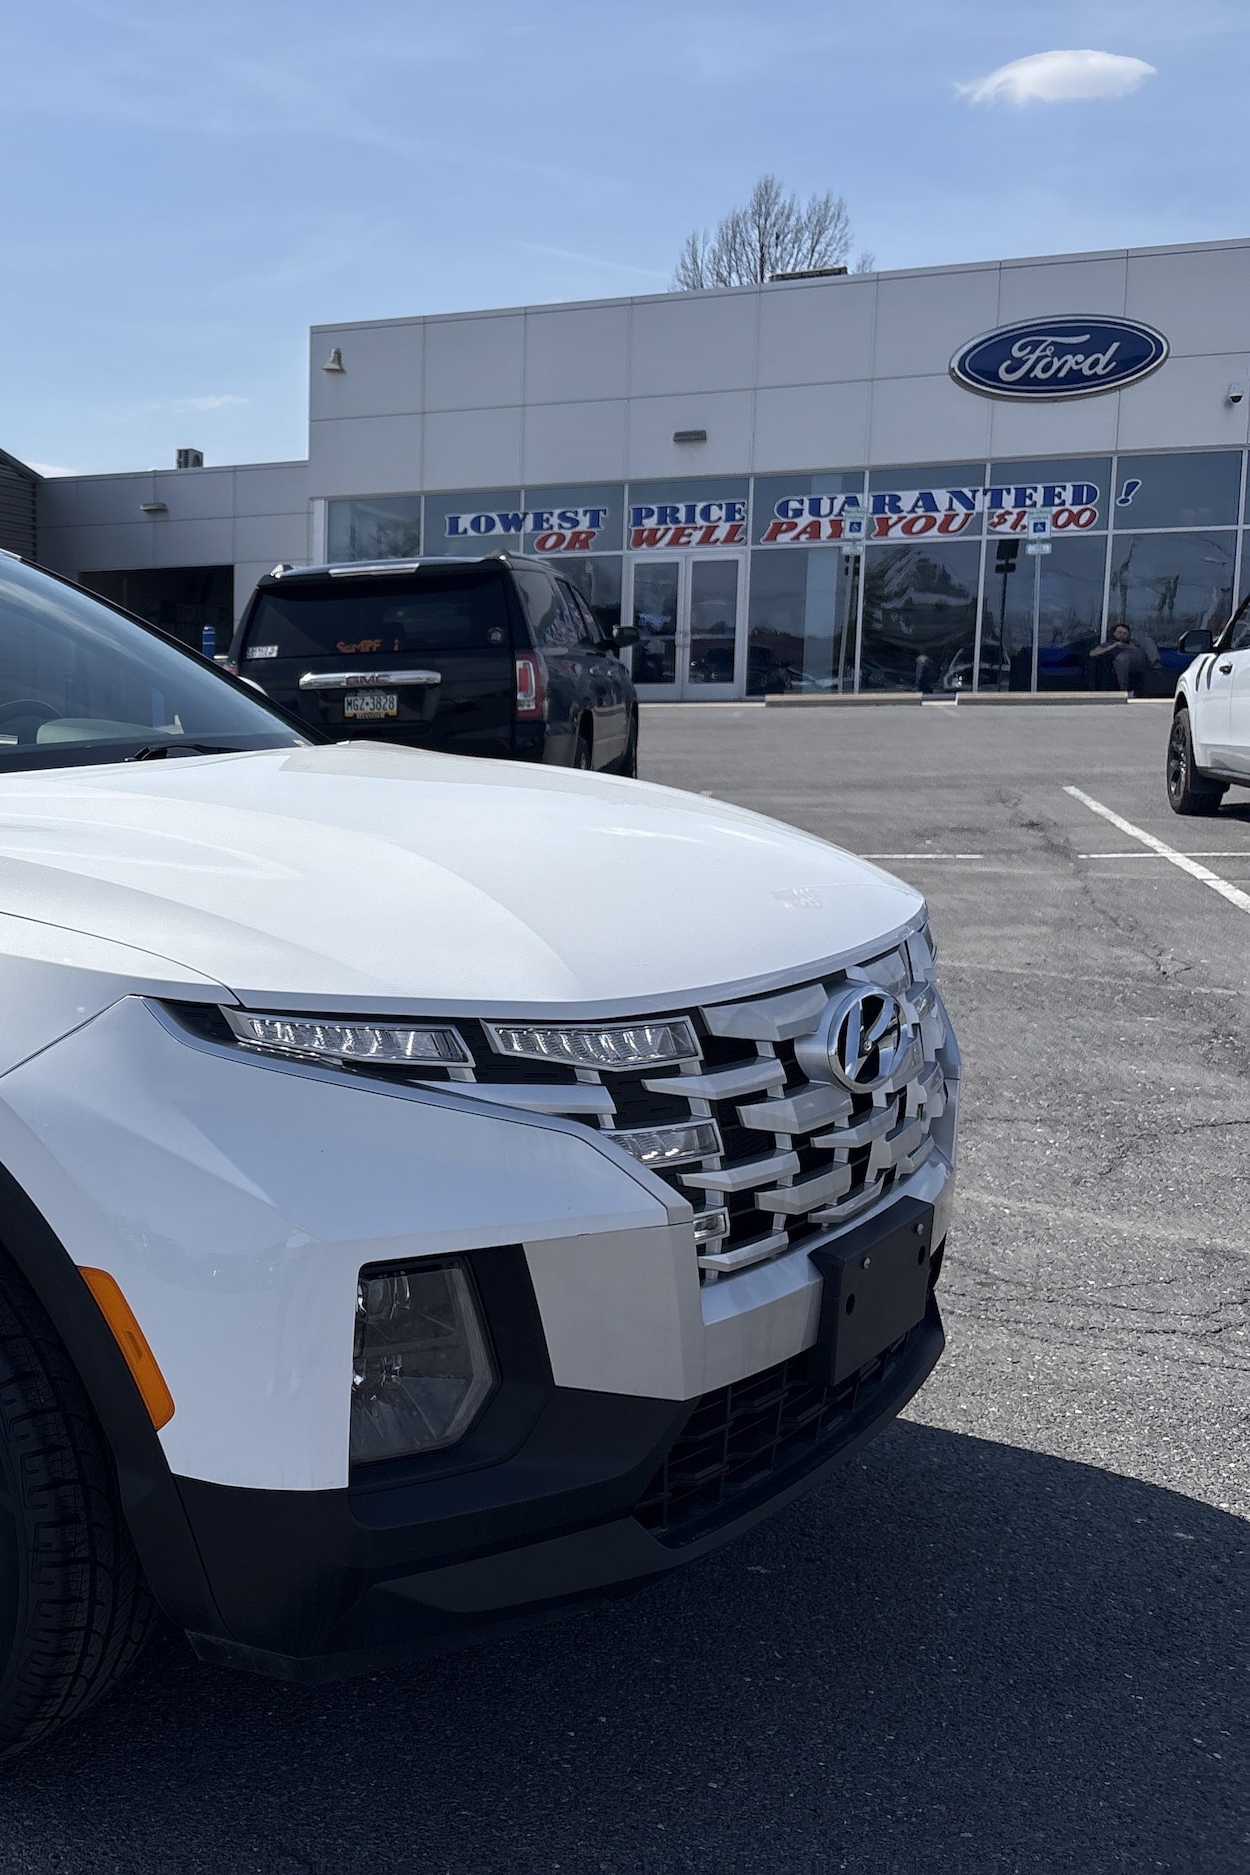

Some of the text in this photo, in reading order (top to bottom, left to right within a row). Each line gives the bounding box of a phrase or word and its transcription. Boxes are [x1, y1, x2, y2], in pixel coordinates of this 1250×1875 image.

[998, 333, 1121, 382] Ford
[447, 508, 607, 536] LOWEST
[631, 502, 746, 527] PRICE
[775, 483, 1099, 520] GUARANTEED
[535, 531, 597, 551] OR
[873, 512, 973, 538] YOU
[988, 507, 1098, 534] $1,00
[345, 674, 391, 687] GMC
